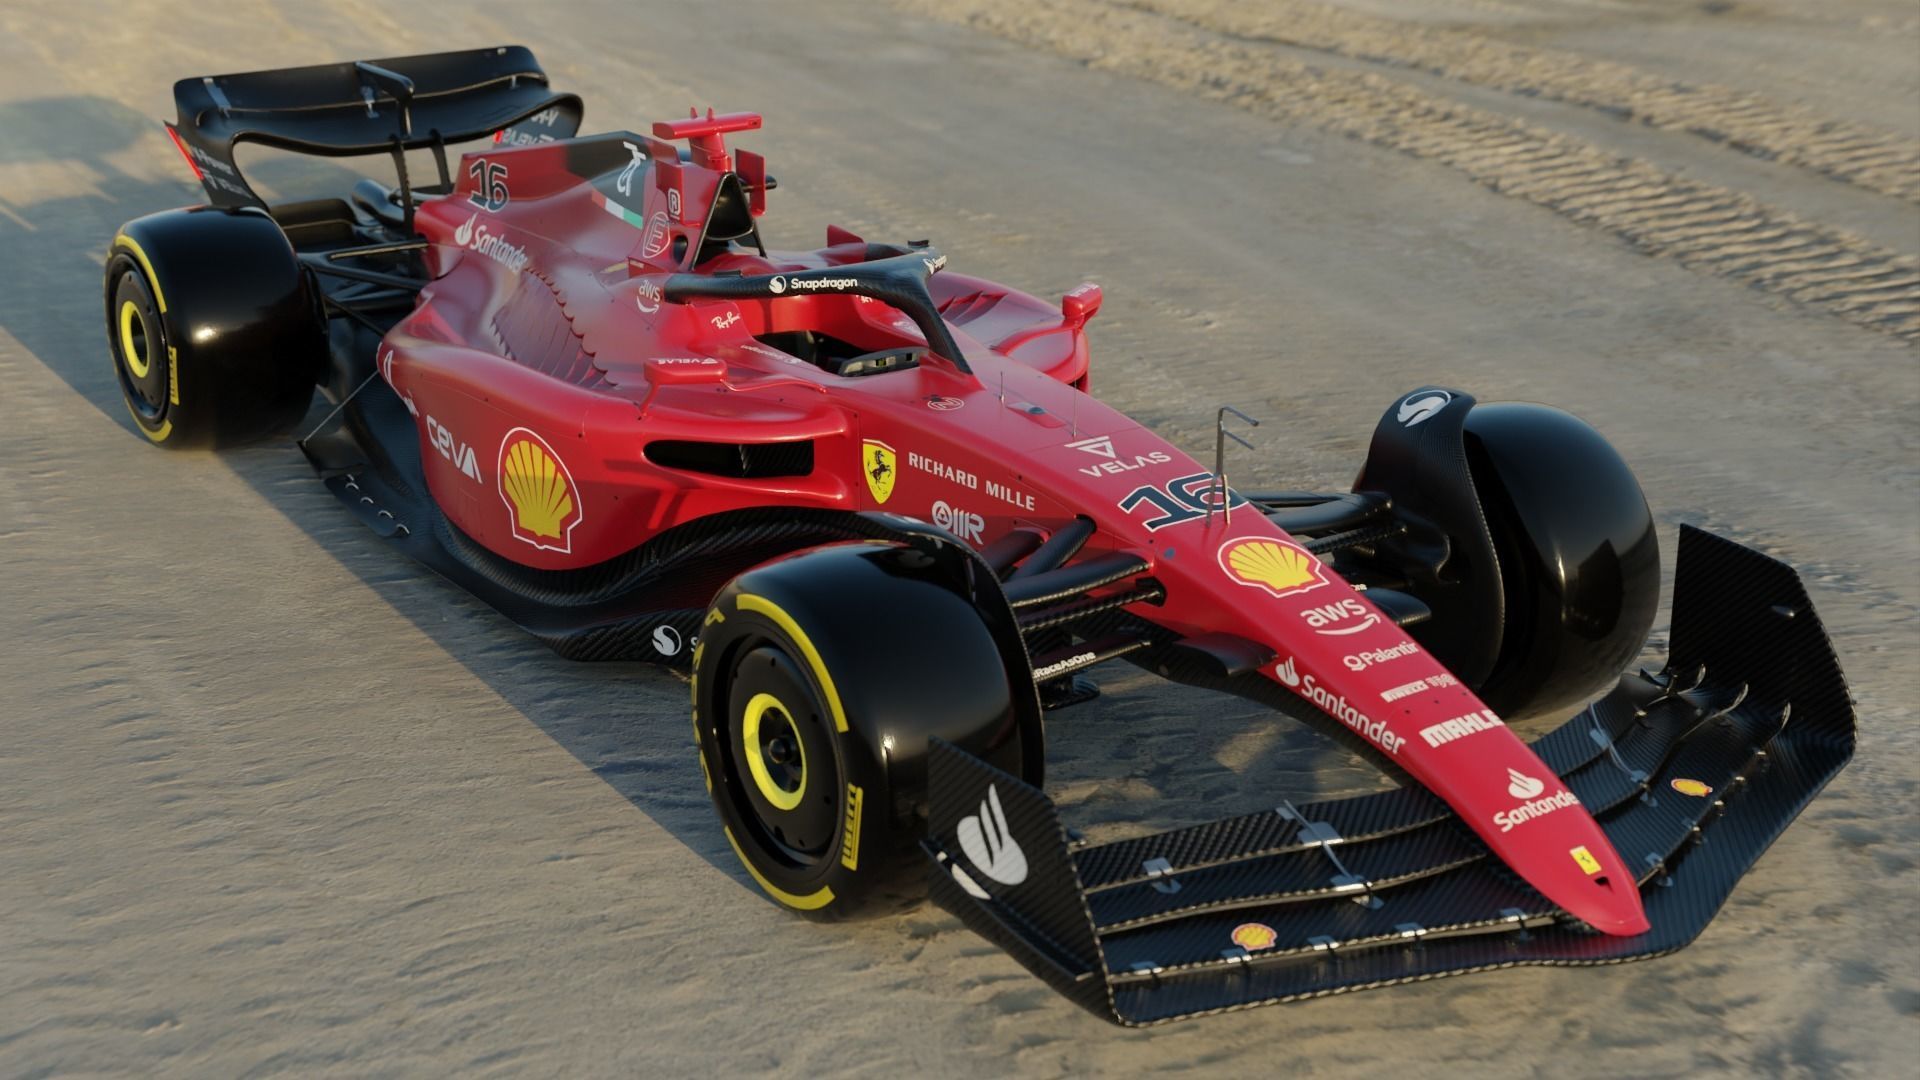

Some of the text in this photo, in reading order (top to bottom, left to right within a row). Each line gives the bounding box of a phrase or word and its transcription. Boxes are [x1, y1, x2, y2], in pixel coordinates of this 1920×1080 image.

[467, 158, 510, 213] 16
[469, 224, 528, 273] Santander
[638, 279, 661, 302] aws
[790, 276, 858, 292] Snapdragon
[908, 451, 1036, 512] RICHARD MILLE
[1078, 451, 1173, 479] VELAS
[1117, 471, 1250, 533] 16
[1300, 598, 1367, 628] aws
[1358, 641, 1421, 666] Palantir
[1301, 673, 1406, 755] Santander
[1419, 709, 1505, 749] MAHLE
[1493, 788, 1581, 833] Santande
